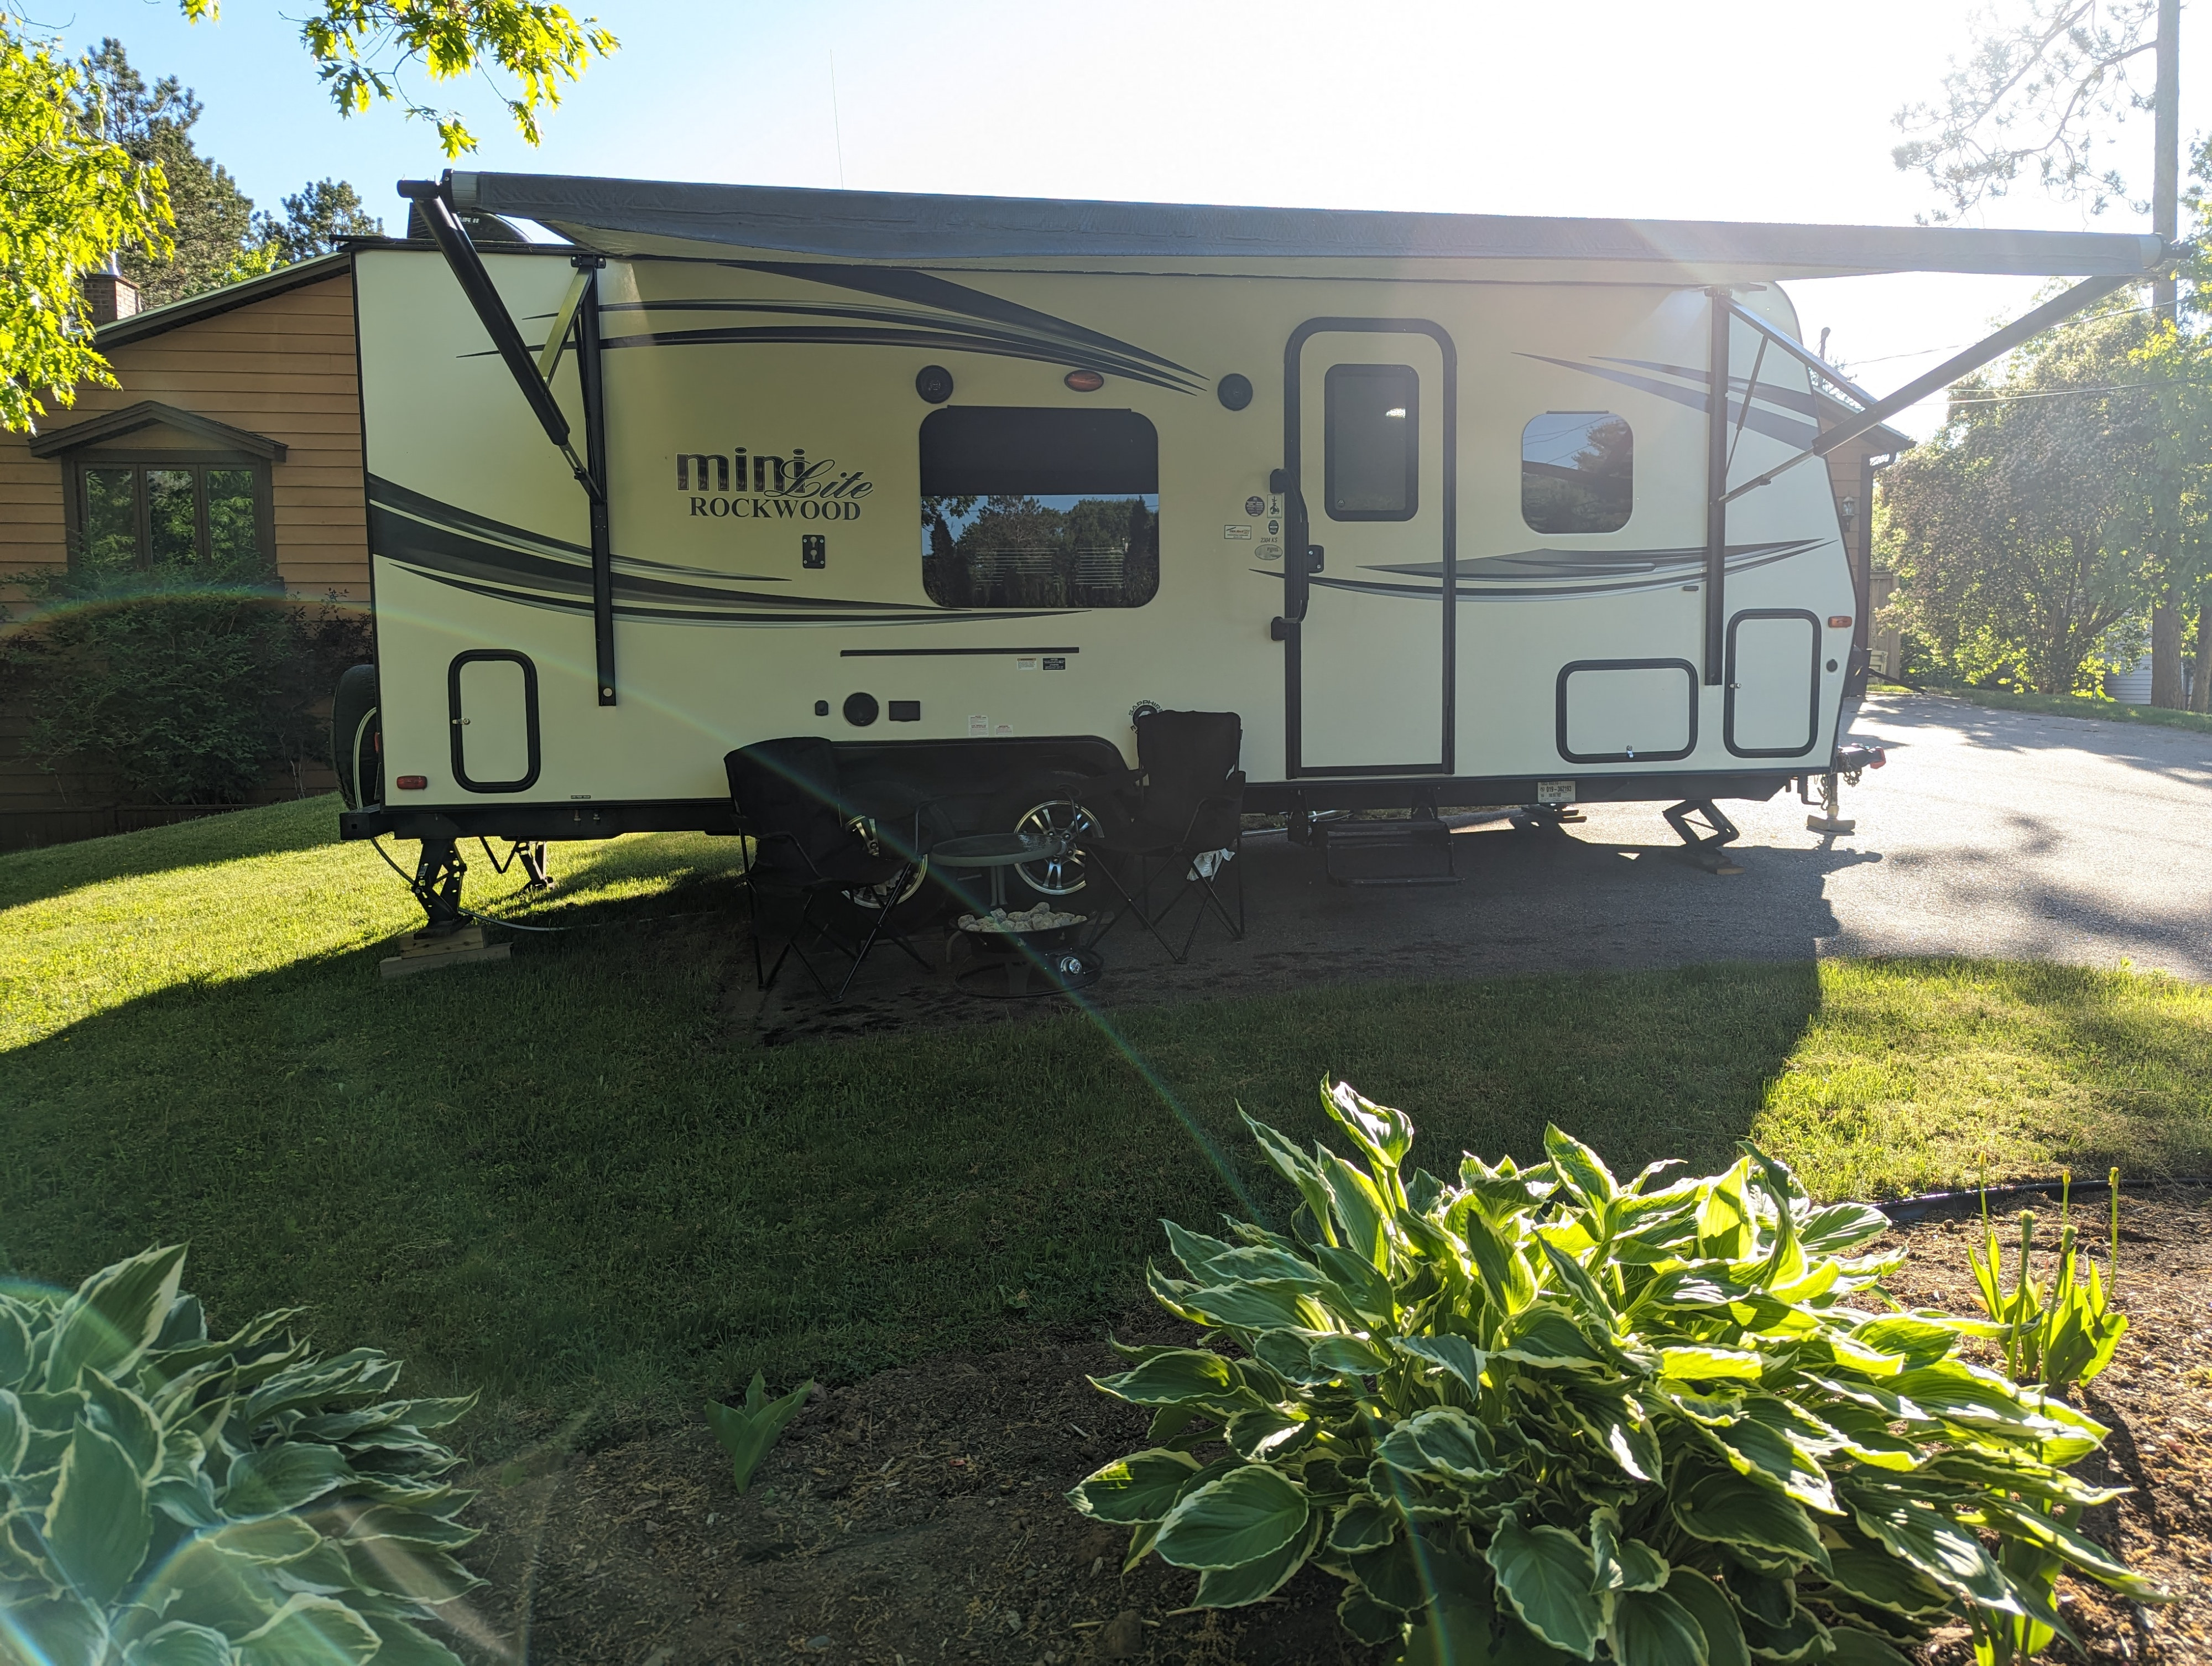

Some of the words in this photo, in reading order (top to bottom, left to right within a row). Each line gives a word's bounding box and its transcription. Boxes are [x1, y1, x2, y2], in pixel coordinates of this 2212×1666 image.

[676, 446, 806, 493] mini
[763, 459, 875, 499] Lite
[688, 496, 861, 520] ROCKWOOD
